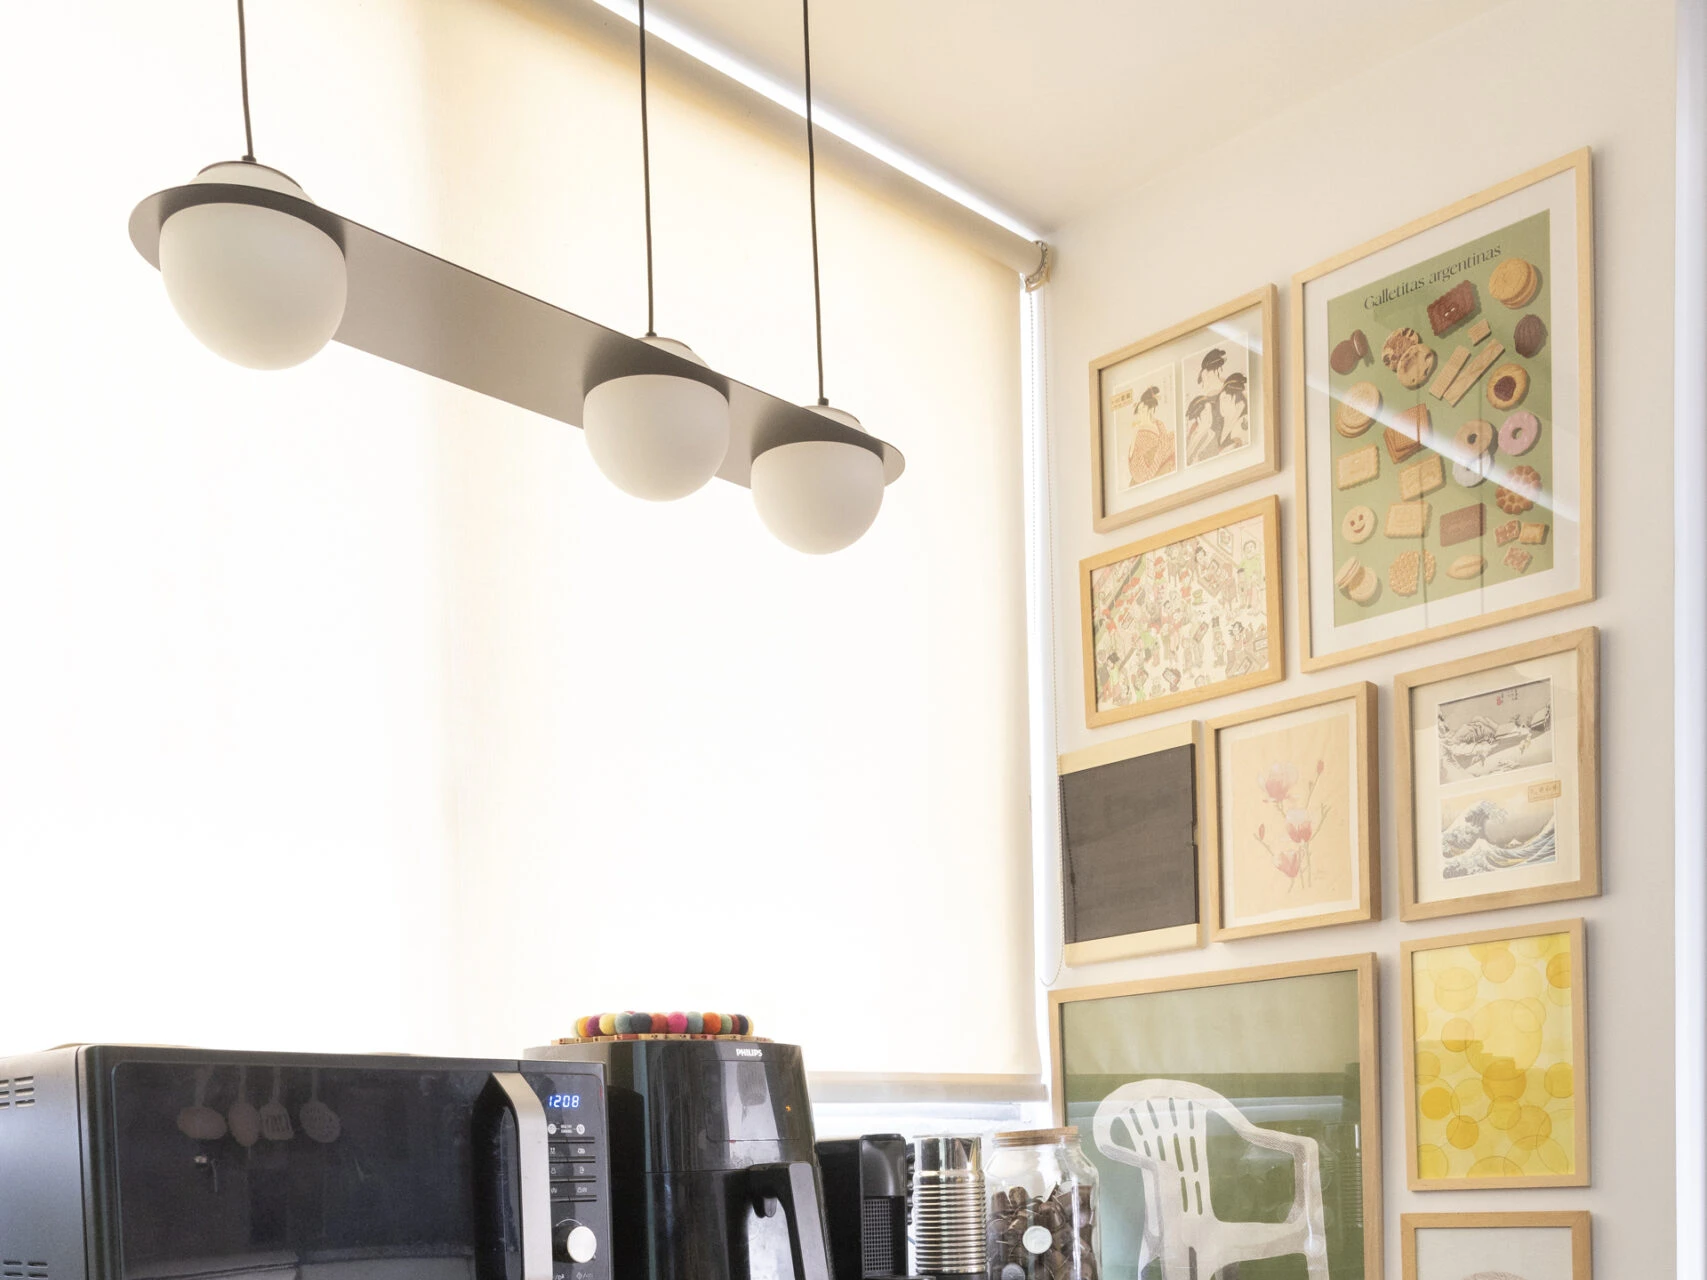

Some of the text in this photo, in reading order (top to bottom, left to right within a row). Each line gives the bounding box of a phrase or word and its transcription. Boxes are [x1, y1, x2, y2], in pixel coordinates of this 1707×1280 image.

[1364, 245, 1502, 310] Galletitas argentinas
[735, 1048, 763, 1057] PHILIPS
[549, 1094, 580, 1108] 1208
